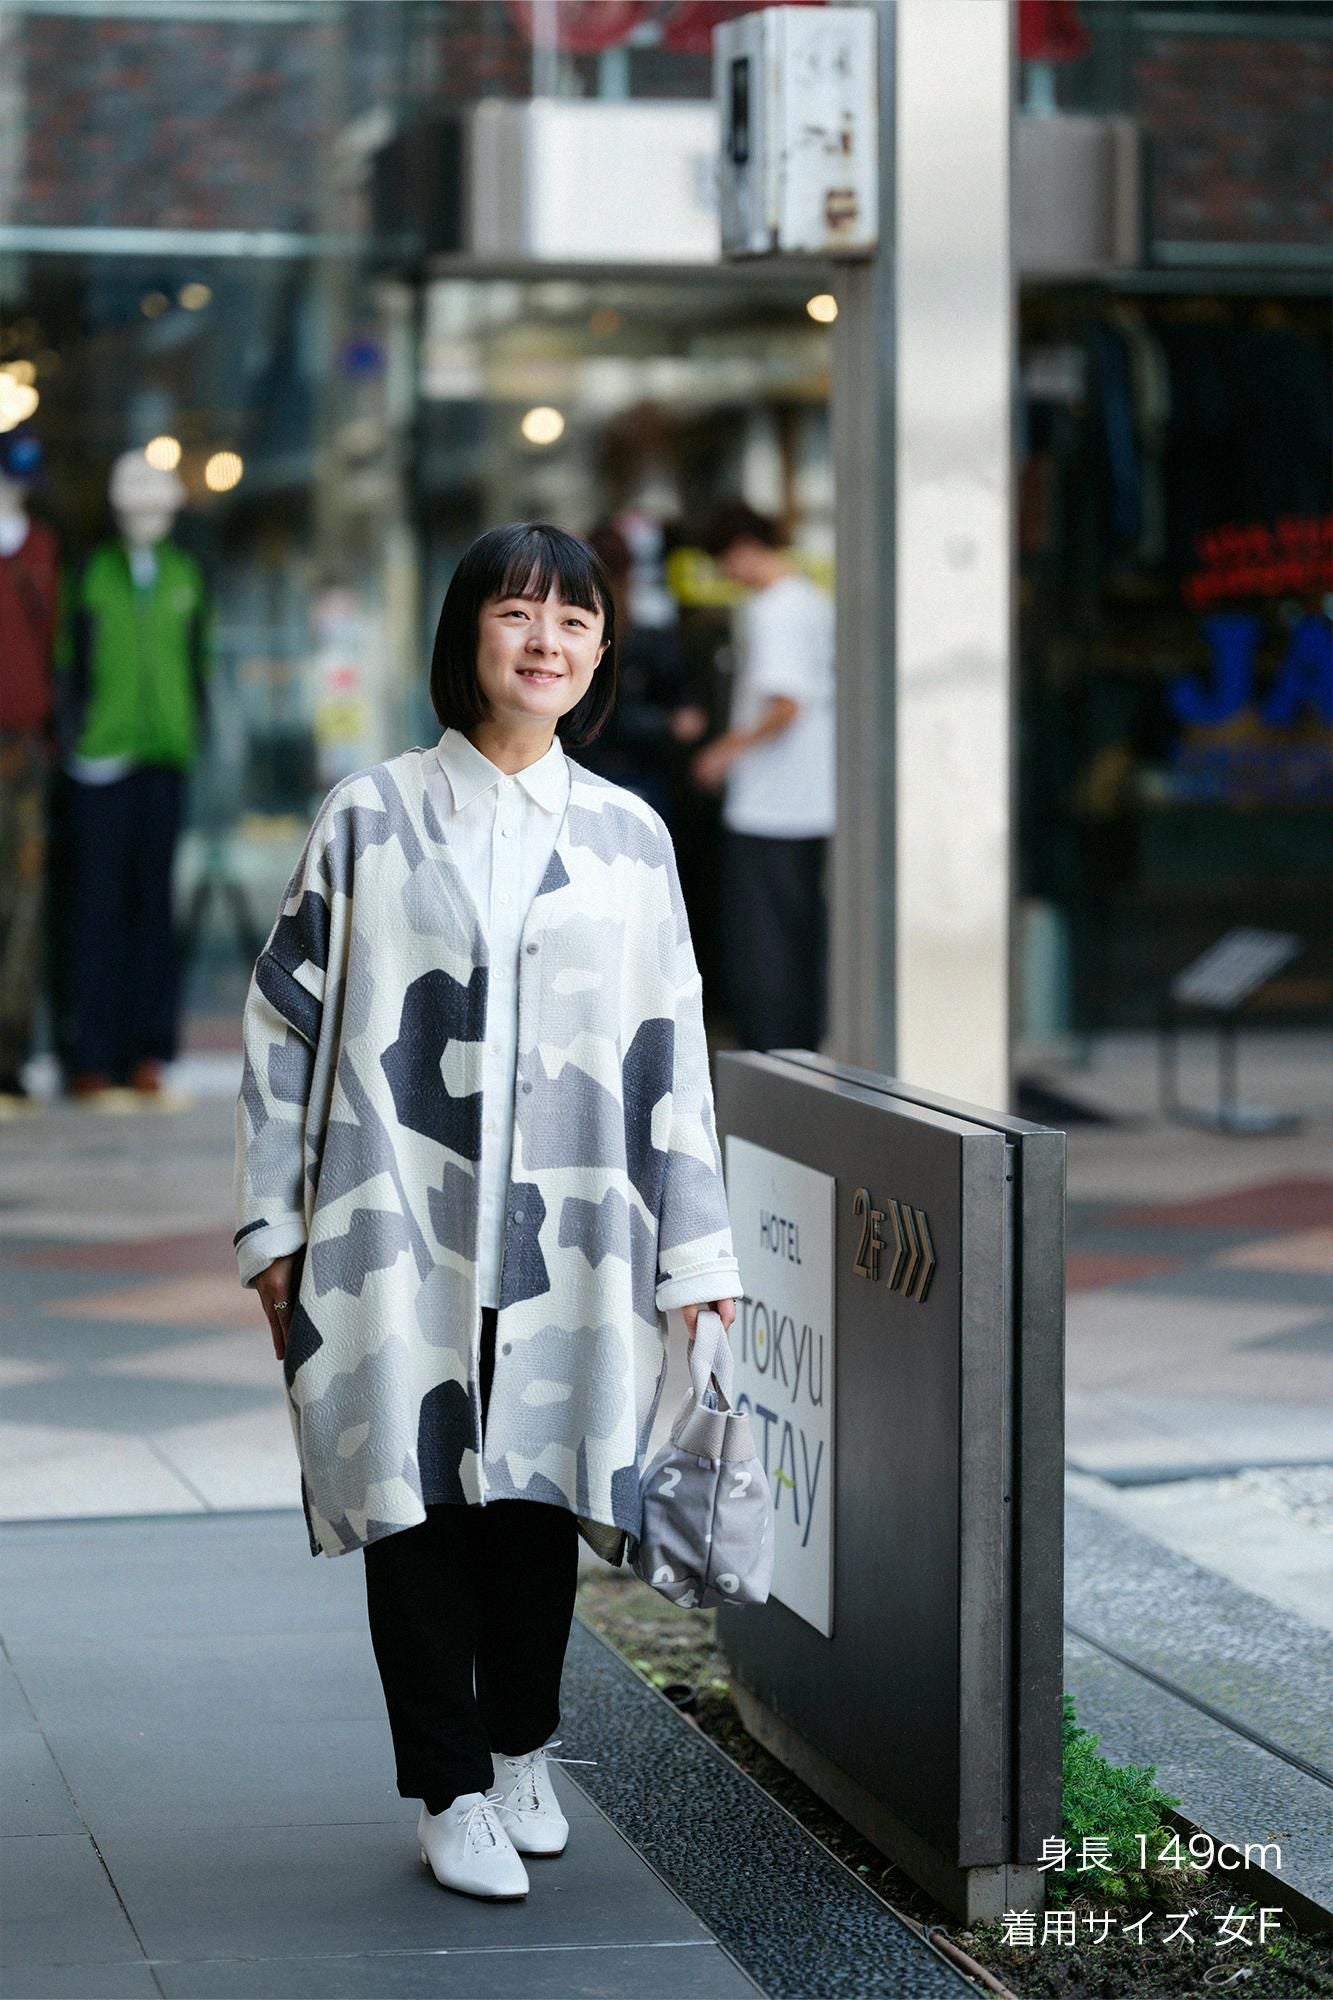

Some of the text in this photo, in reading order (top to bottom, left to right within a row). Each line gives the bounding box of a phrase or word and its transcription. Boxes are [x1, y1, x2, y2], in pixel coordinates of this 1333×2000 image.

[760, 1209, 802, 1265] HOTEL
[852, 1187, 886, 1281] 2F
[658, 1467, 752, 1498] 2 2
[737, 1393, 824, 1547] TAY
